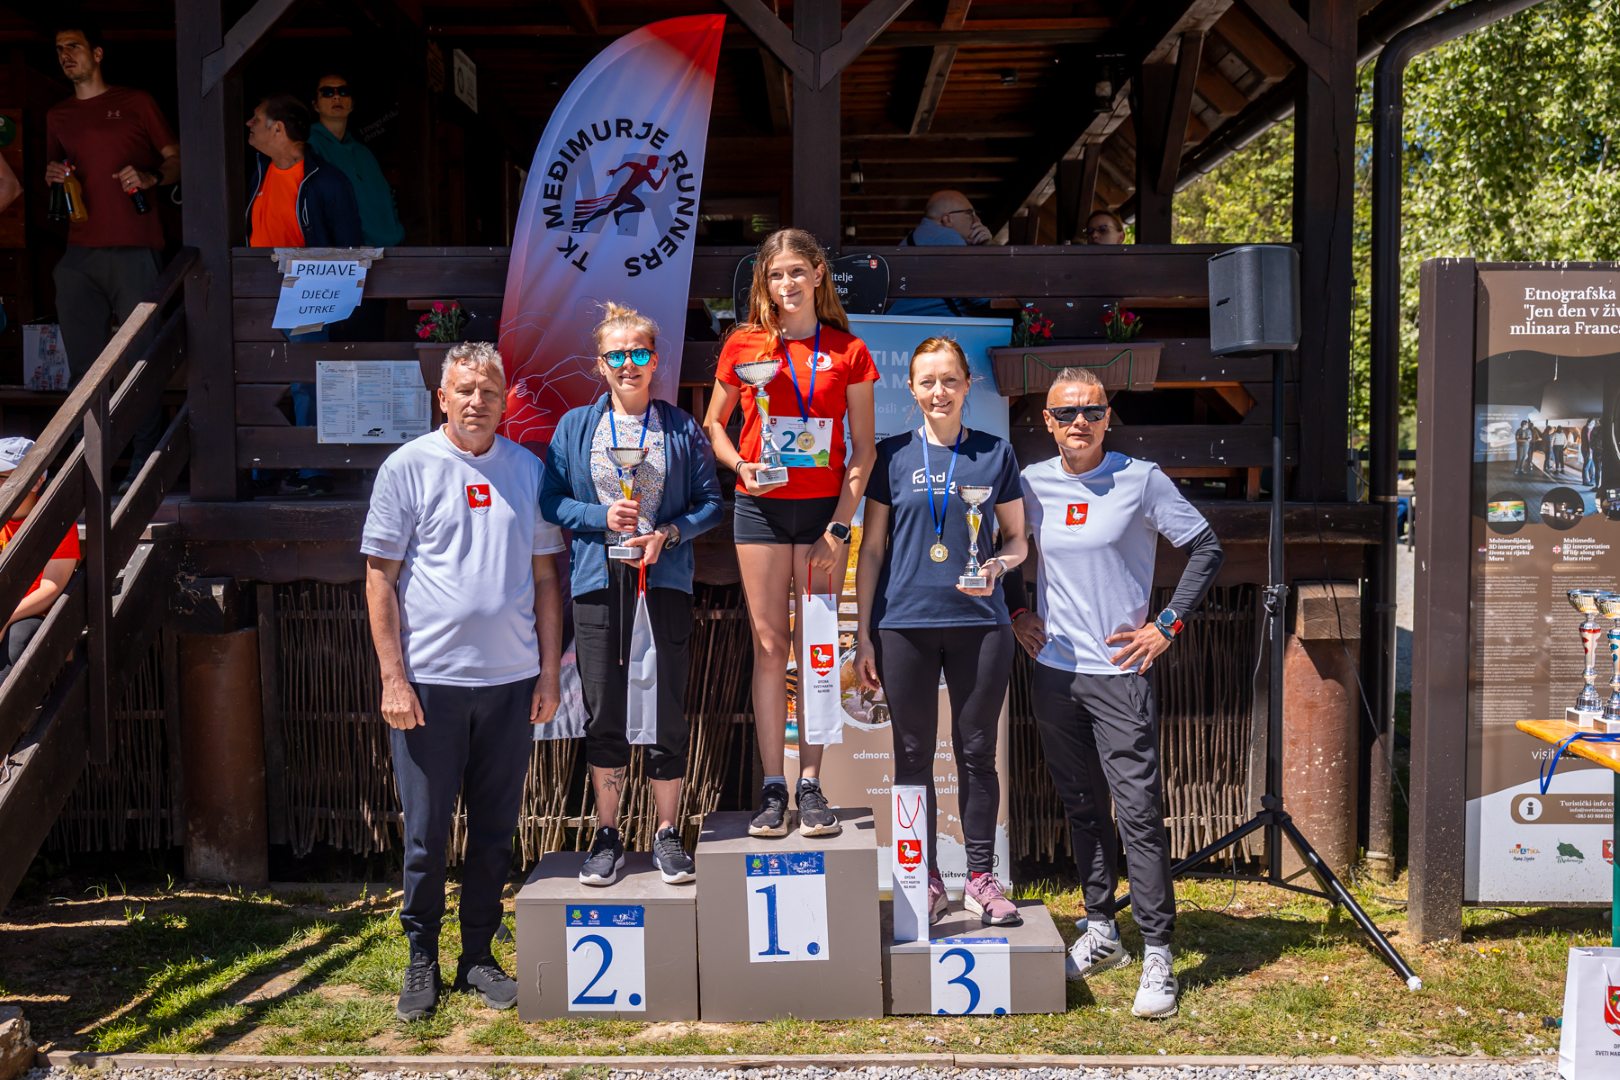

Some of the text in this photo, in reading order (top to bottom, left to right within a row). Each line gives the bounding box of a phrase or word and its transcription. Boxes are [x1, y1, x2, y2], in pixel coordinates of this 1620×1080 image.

[543, 118, 695, 277] TK MEĐIMURJE RUNNERS
[296, 263, 357, 276] PRIJAVE
[831, 272, 853, 282] itelje
[301, 289, 341, 299] DJEČJE
[1524, 286, 1617, 304] Etnografska
[298, 305, 336, 314] UTRKE
[1523, 304, 1554, 321] "Jen
[1558, 304, 1586, 318] den
[1590, 307, 1600, 317] v
[1510, 321, 1571, 334] mlinara
[781, 430, 809, 453] 2
[853, 751, 890, 760] odmora
[947, 773, 959, 783] fo
